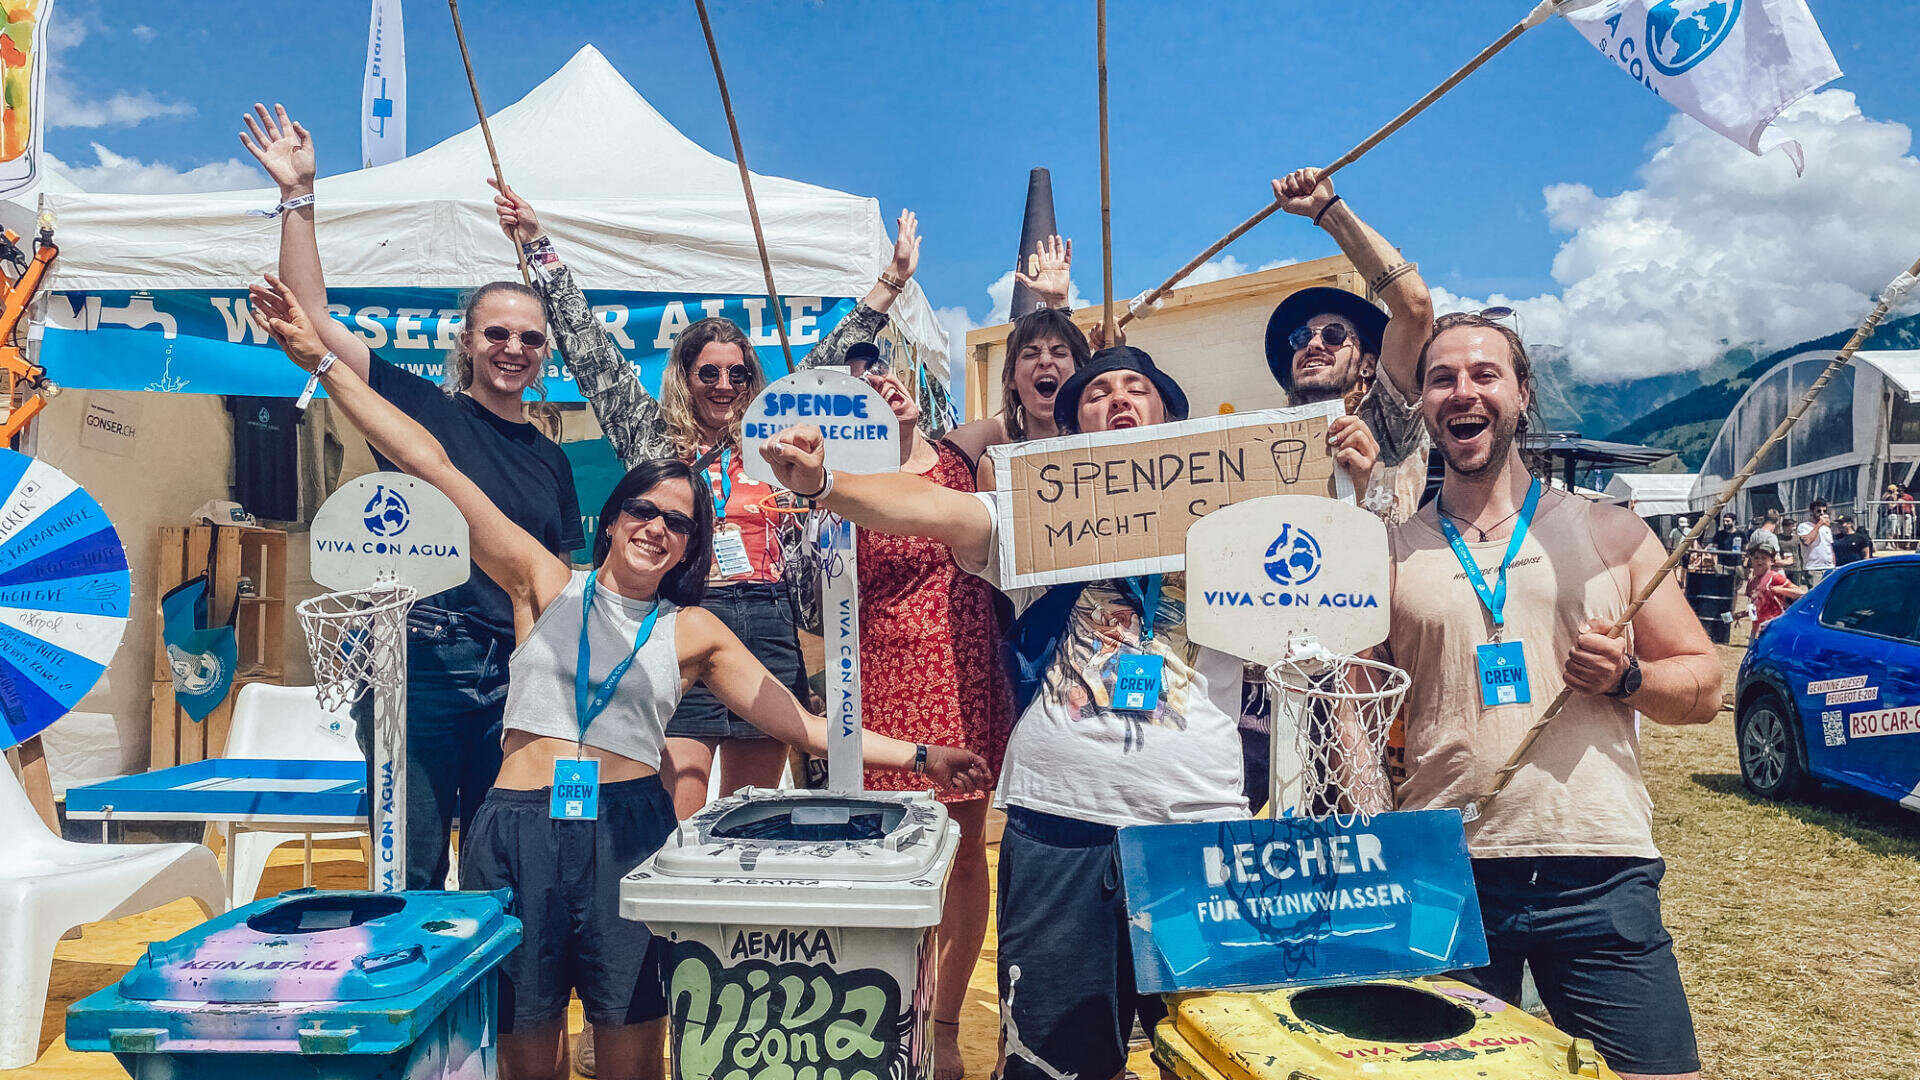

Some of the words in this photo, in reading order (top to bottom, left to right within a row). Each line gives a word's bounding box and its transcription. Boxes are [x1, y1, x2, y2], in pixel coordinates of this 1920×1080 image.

[763, 392, 869, 419] SPENDE
[1037, 448, 1246, 503] SPENDEN
[0, 499, 37, 540] ICKER
[1044, 511, 1157, 548] MACHT
[316, 540, 355, 553] VIVA
[362, 542, 401, 555] CON
[408, 544, 460, 557] AGUA
[1204, 591, 1254, 606] VIVA
[1262, 592, 1309, 606] CON
[1318, 593, 1378, 608] AGUA
[839, 599, 851, 638] VIVA
[841, 644, 852, 683] CON
[1484, 668, 1522, 685] CREW
[1119, 677, 1156, 692] CREW
[1808, 681, 1841, 693] GEWINNE
[1827, 691, 1857, 704] PEUGEOT
[1857, 689, 1877, 700] E-208
[842, 691, 854, 738] AGUA
[1852, 714, 1878, 735] RSO
[381, 759, 394, 815] AGUA
[557, 784, 594, 799] CREW
[381, 820, 394, 863] CON
[1203, 833, 1387, 888] BECHER
[1197, 894, 1241, 923] FÜR
[1246, 883, 1405, 919] TRINKWASSER
[730, 929, 836, 964] AEMKA
[179, 960, 246, 970] KEIN
[244, 960, 340, 971] ABFALL
[732, 1028, 821, 1069] con
[1337, 1047, 1401, 1059] VIVA
[1405, 1040, 1464, 1053] CON
[1469, 1035, 1539, 1048] AGUA
